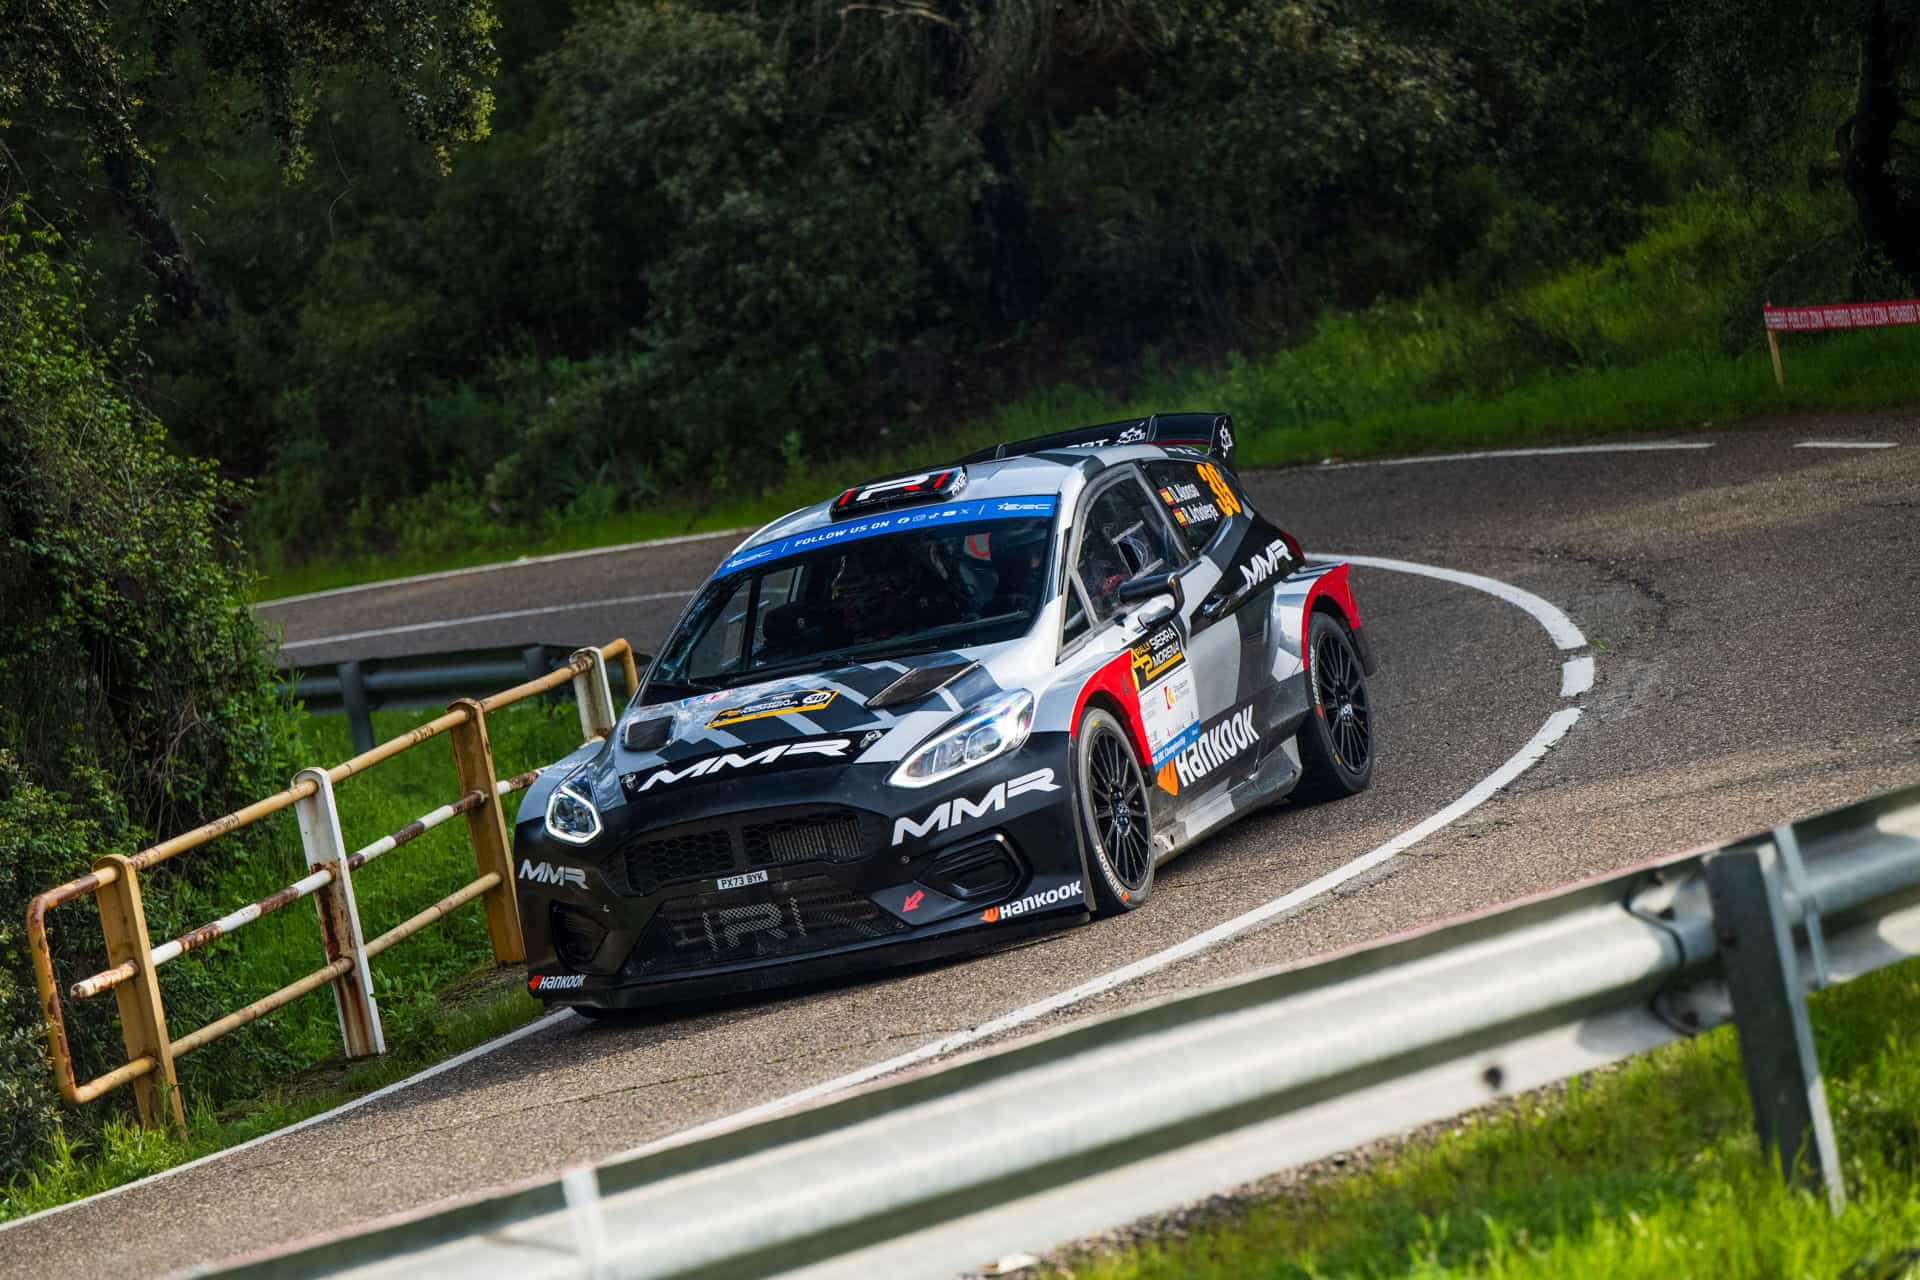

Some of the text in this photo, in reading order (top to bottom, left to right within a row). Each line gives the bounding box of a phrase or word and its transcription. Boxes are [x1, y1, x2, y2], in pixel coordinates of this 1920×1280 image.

[794, 520, 890, 547] FOLLOW US ON
[1240, 539, 1293, 590] MMR
[1149, 627, 1177, 650] SIERRA
[638, 739, 851, 792] MMR
[891, 768, 1062, 846] MMR
[518, 859, 590, 889] MMR
[720, 876, 745, 889] PX73
